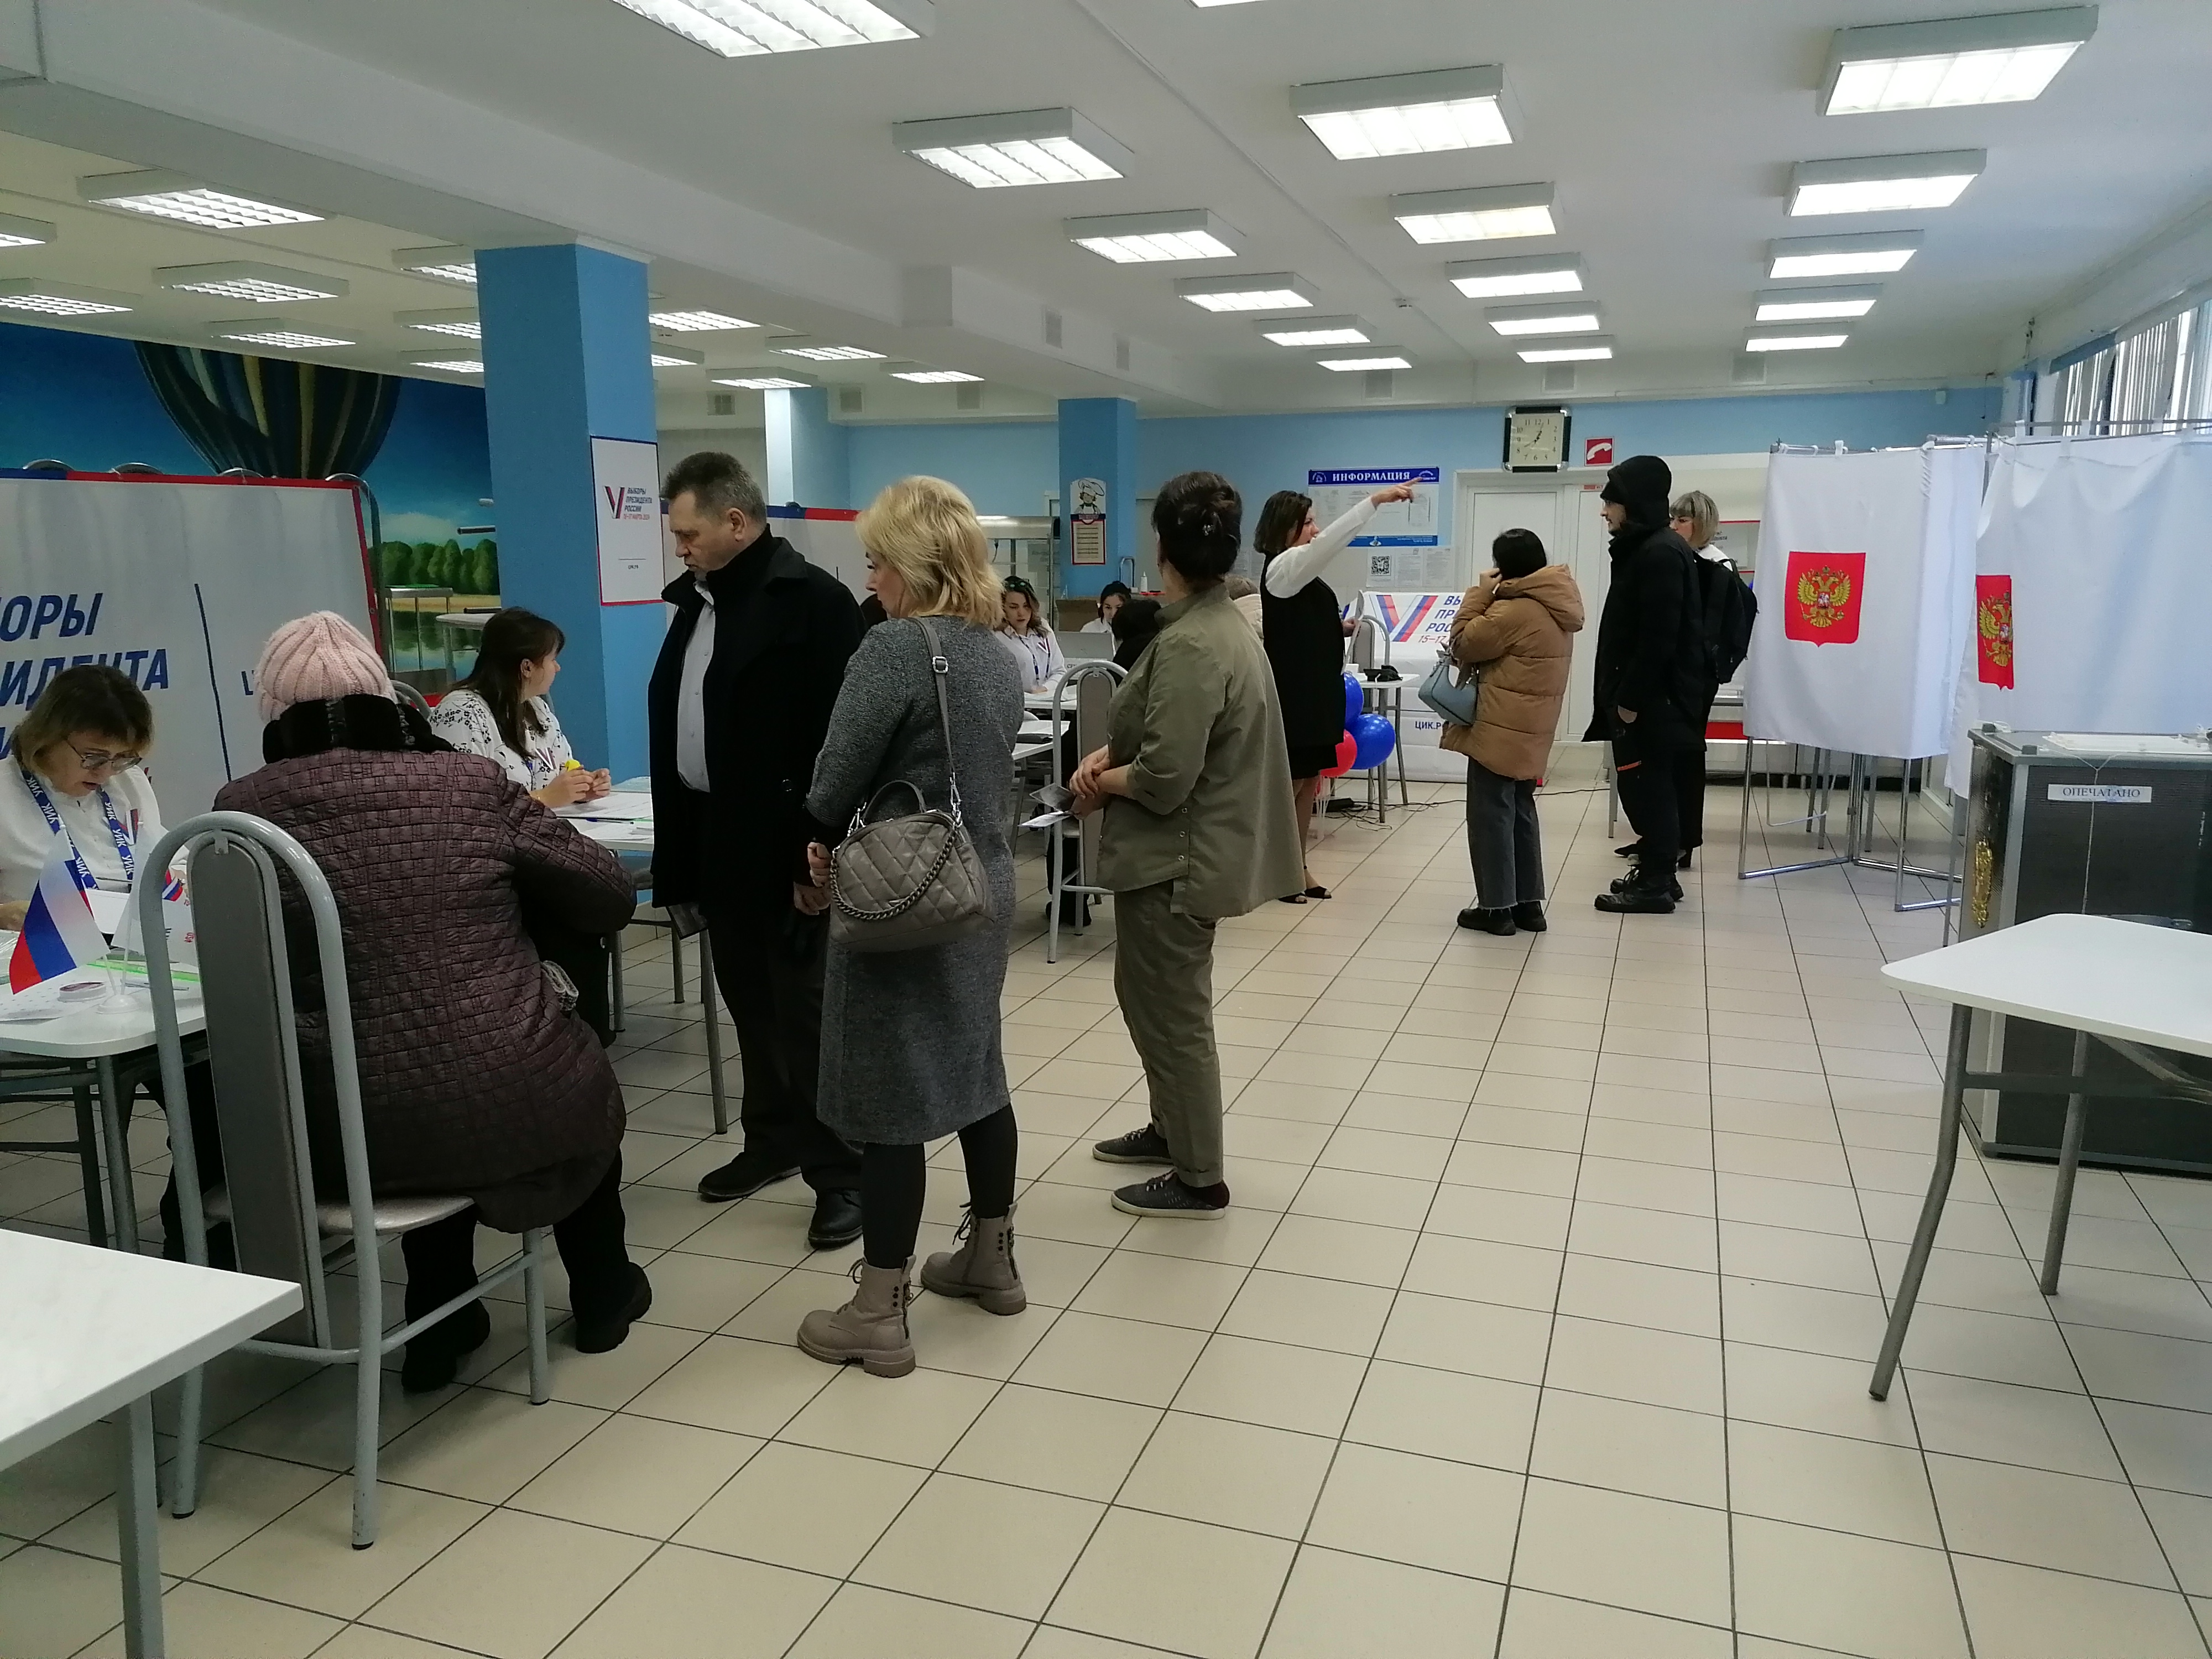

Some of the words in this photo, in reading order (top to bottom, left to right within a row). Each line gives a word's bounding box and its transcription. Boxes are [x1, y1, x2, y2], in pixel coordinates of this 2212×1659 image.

[1332, 472, 1410, 482] ИНФОРМАЦИЯ
[0, 593, 103, 641] ОРЫ
[1425, 623, 1452, 632] РОС
[1415, 721, 1442, 730] ЦИК.Р
[25, 775, 43, 797] УИК
[2063, 787, 2141, 797] ОПЕЧАТАНО
[41, 801, 59, 825] УИК
[104, 801, 117, 821] УИК
[112, 828, 127, 848] УИК
[122, 854, 134, 875] УИК
